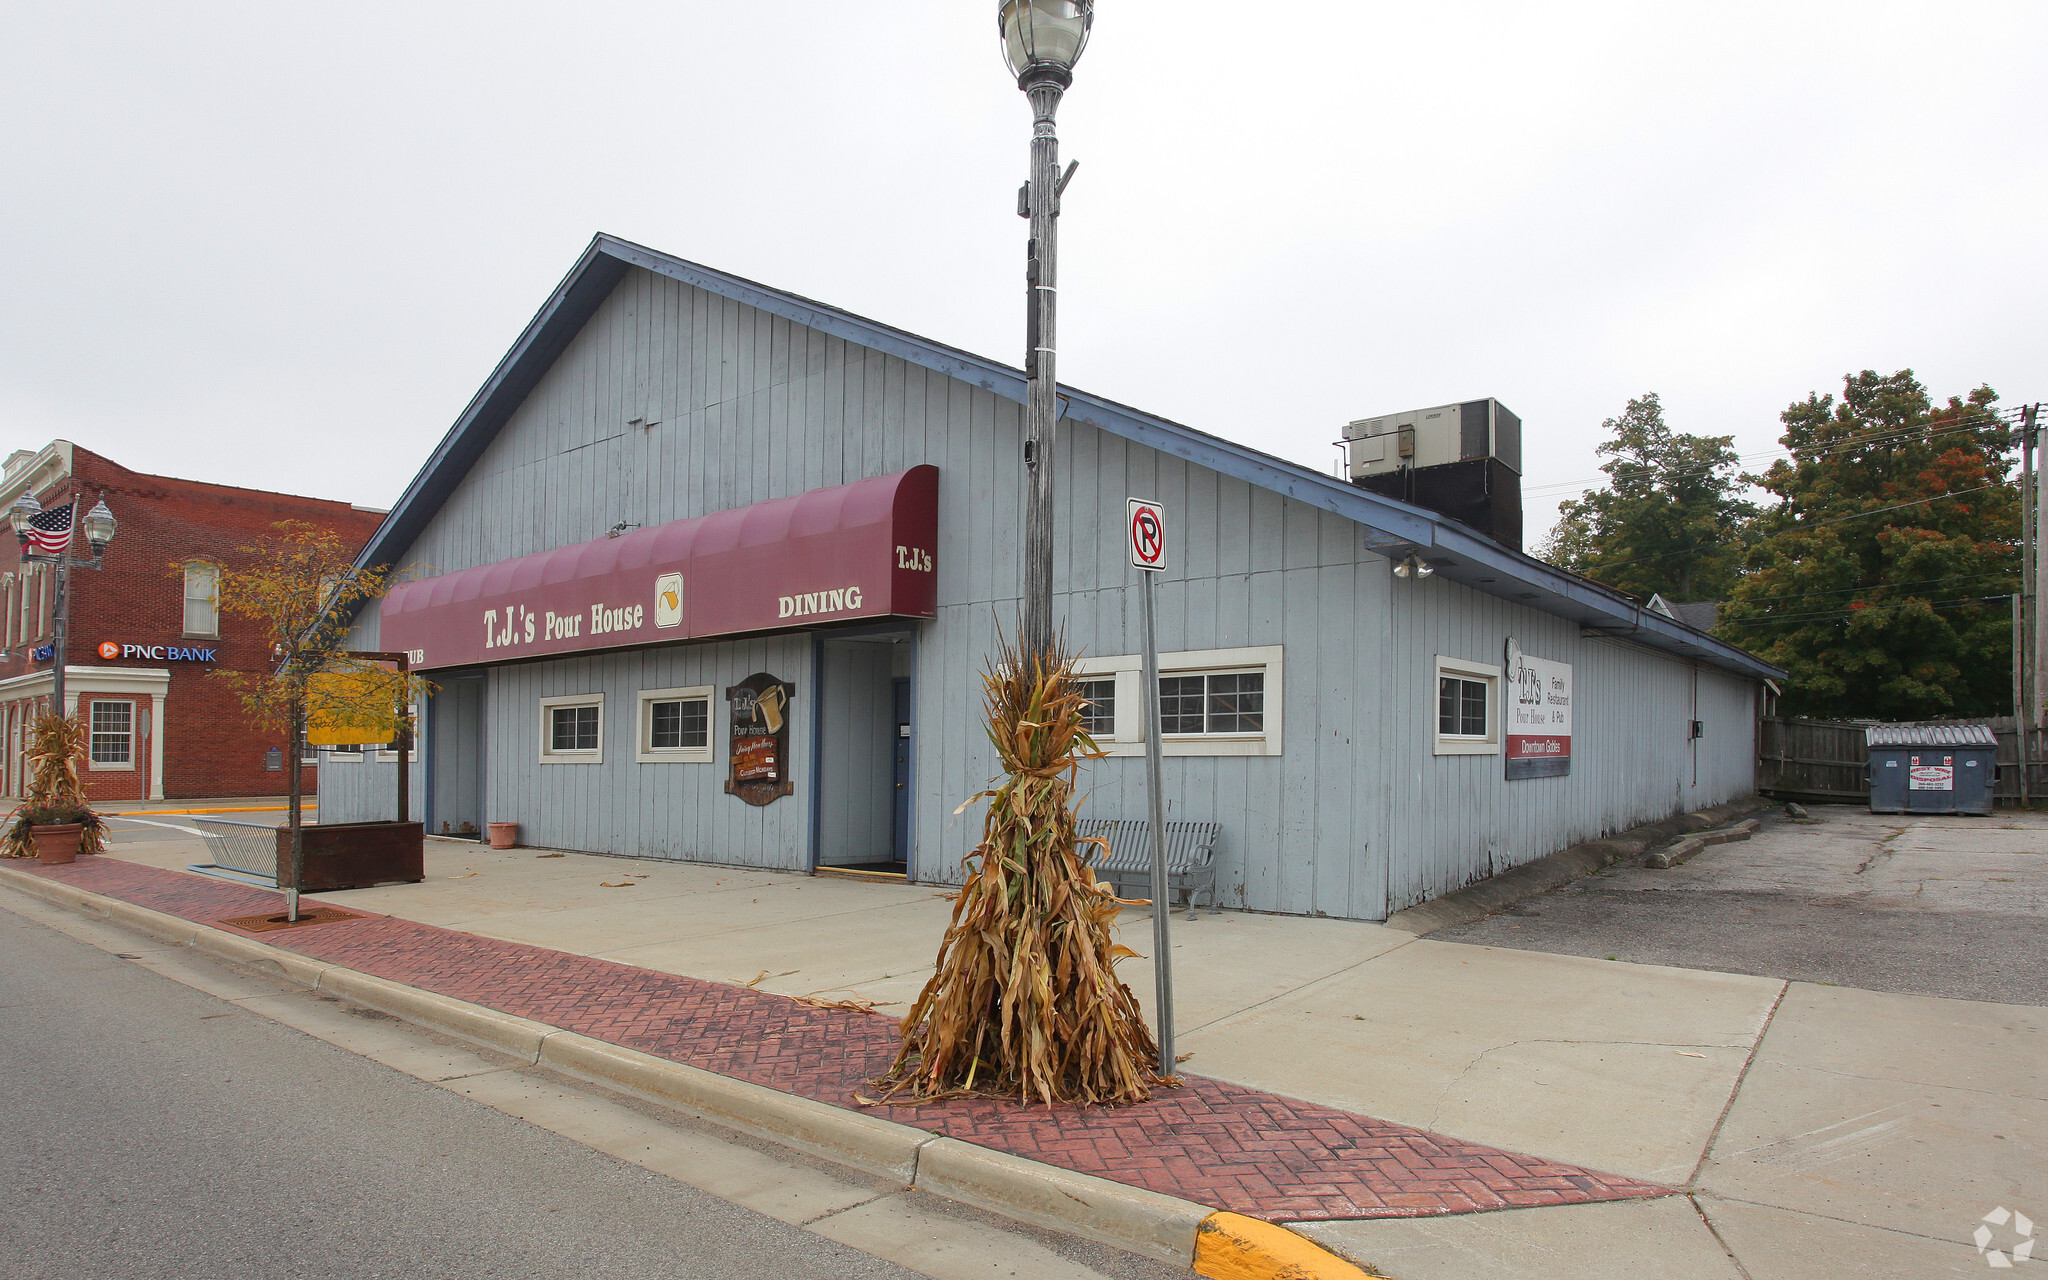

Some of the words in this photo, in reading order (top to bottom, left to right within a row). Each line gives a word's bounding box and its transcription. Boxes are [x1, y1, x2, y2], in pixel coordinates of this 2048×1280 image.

[896, 545, 932, 573] T.J.'s
[778, 586, 863, 619] DINING
[484, 604, 536, 649] T.J.'s
[545, 611, 582, 641] Pour
[590, 603, 643, 635] House
[122, 644, 165, 660] PNC
[166, 646, 217, 662] BANK
[1551, 676, 1565, 692] Family
[1546, 692, 1569, 706] Restaurant
[1516, 707, 1529, 724] Pour
[1530, 708, 1546, 725] House
[1556, 710, 1565, 723] Pub
[734, 724, 748, 735] Pour
[749, 724, 767, 735] House
[1521, 739, 1545, 753] Downtown
